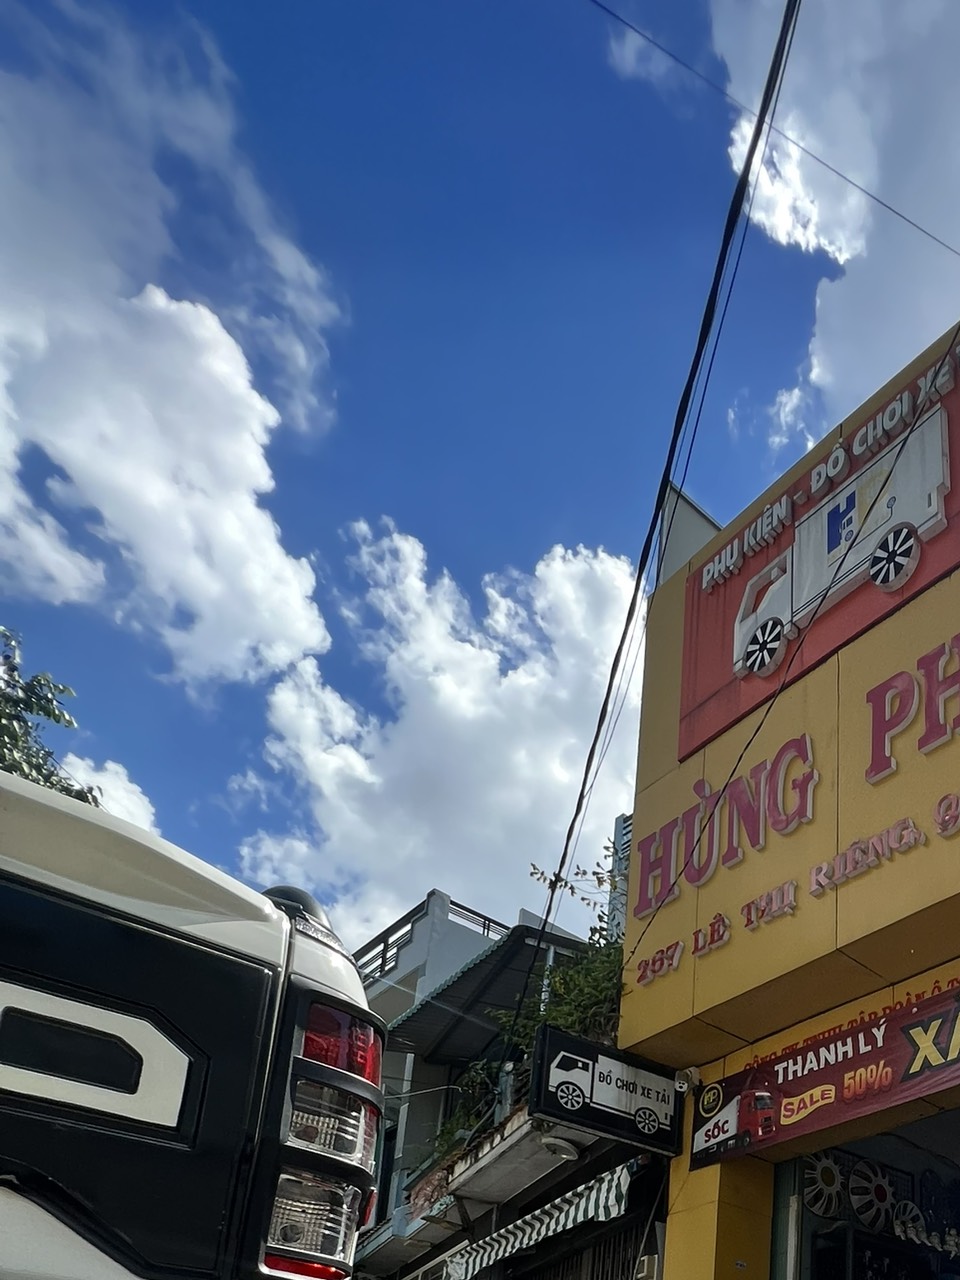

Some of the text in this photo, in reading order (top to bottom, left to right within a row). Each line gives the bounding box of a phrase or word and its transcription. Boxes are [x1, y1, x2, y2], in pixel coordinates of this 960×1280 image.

[702, 542, 743, 592] PHỤ
[743, 494, 792, 555] KIỆN
[810, 439, 849, 494] ĐỒ
[852, 392, 914, 457] CHƠI
[917, 354, 955, 406] XE
[633, 733, 819, 919] HÙNG
[636, 940, 685, 985] 267
[692, 911, 731, 957] LÊ
[741, 880, 798, 930] THỊ
[774, 1017, 888, 1084] THANH LÝ
[615, 1077, 638, 1095] CHƠI
[641, 1083, 653, 1100] XE
[783, 1060, 894, 1119] SALE 50%
[704, 1114, 730, 1144] SỐC
